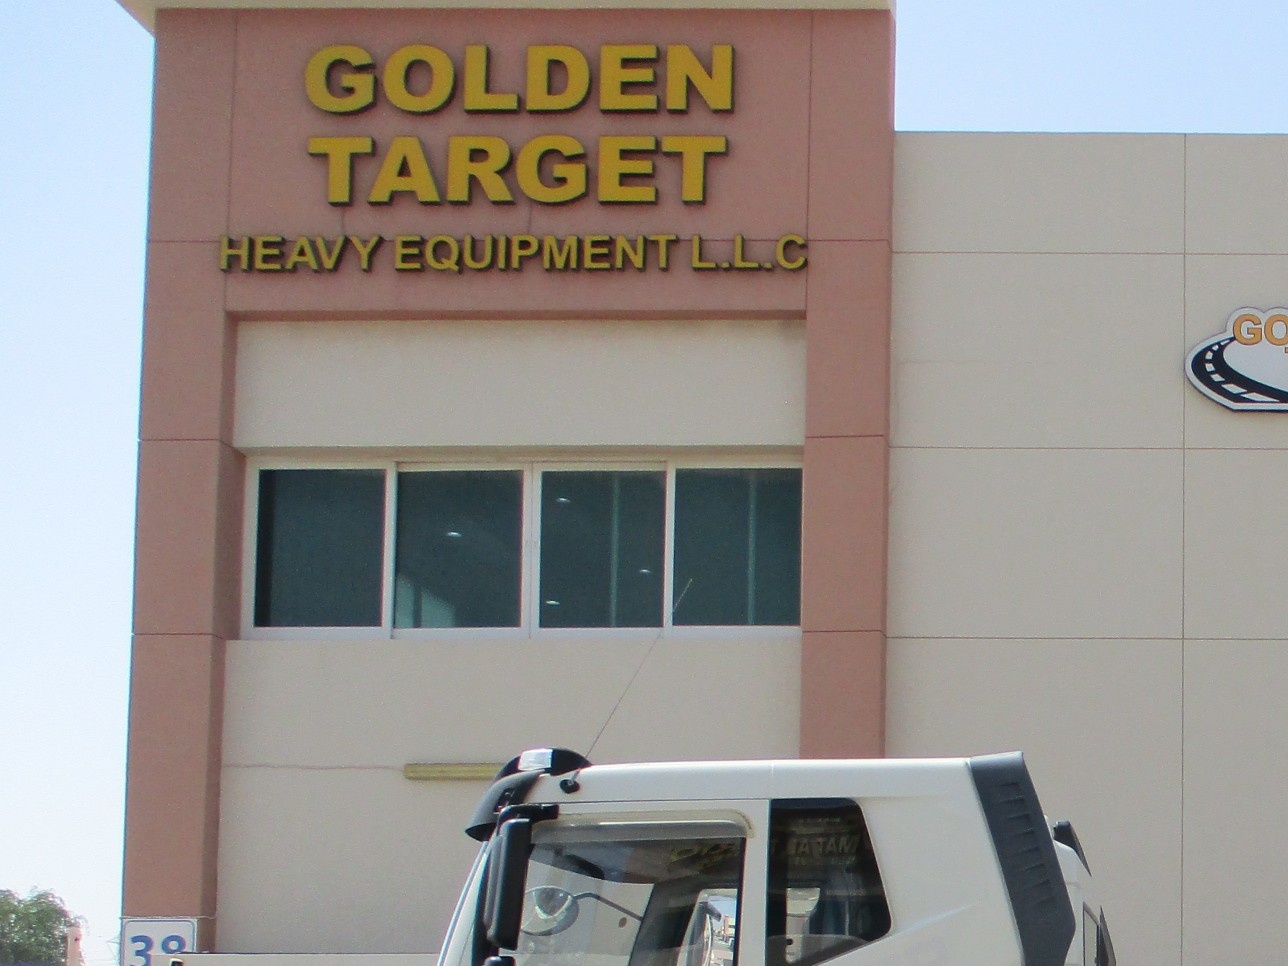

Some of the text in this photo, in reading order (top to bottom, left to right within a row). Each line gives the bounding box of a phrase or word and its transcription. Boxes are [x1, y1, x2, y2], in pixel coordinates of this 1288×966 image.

[304, 44, 736, 114] GOLDEN
[308, 135, 728, 207] TARGET
[218, 234, 808, 274] HEAVY EQUIPMENT L.L.C
